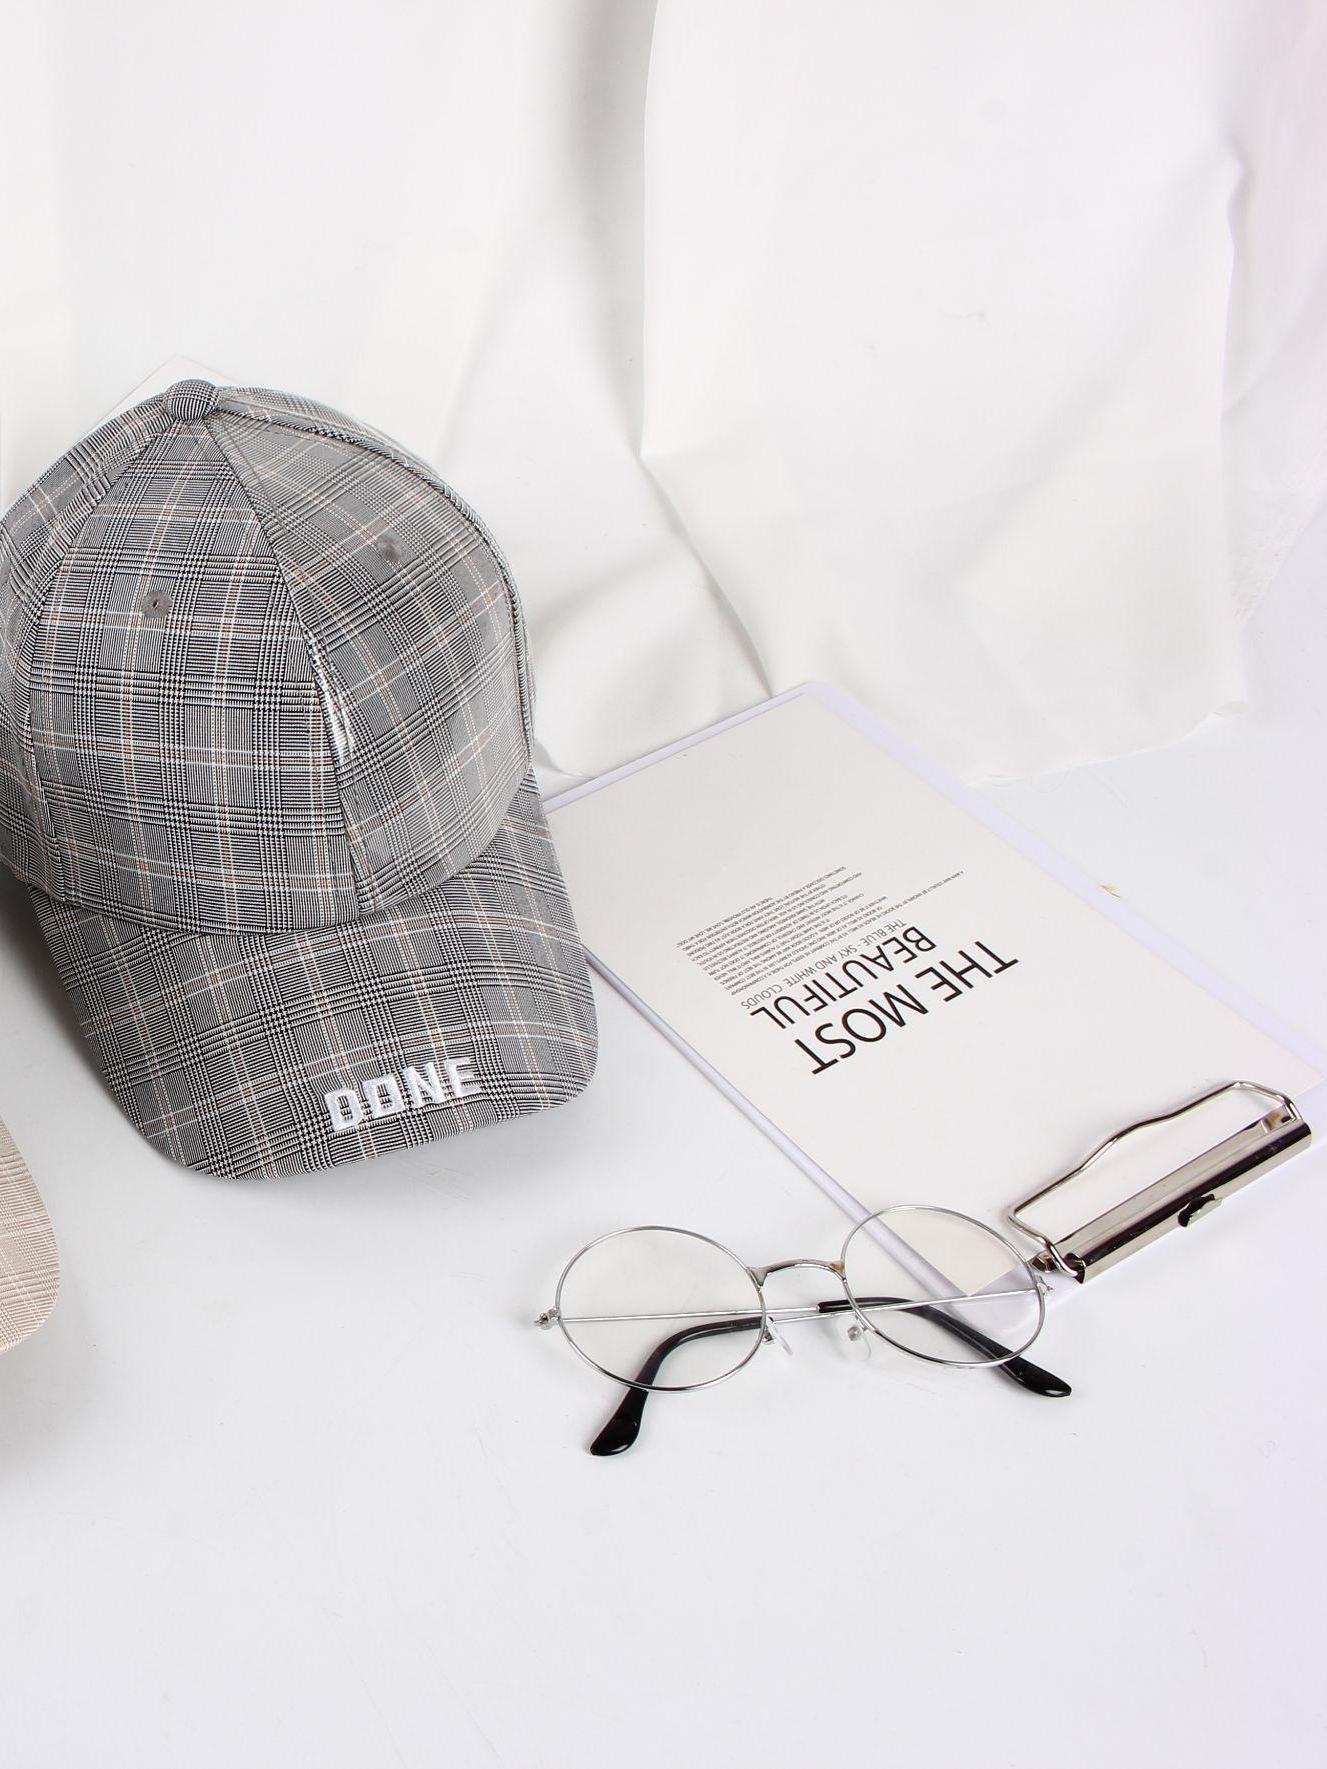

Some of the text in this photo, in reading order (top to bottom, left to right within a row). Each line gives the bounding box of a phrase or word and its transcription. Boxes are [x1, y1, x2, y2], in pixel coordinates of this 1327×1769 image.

[883, 919, 907, 934] THE
[860, 928, 887, 947] BLUE
[814, 954, 838, 970] AND
[837, 944, 858, 960] SKY
[750, 926, 936, 1029] BEAUTIFUL
[782, 966, 818, 988] WHITE
[740, 985, 783, 1010] CLOUDS
[794, 941, 1019, 1075] THE MOST
